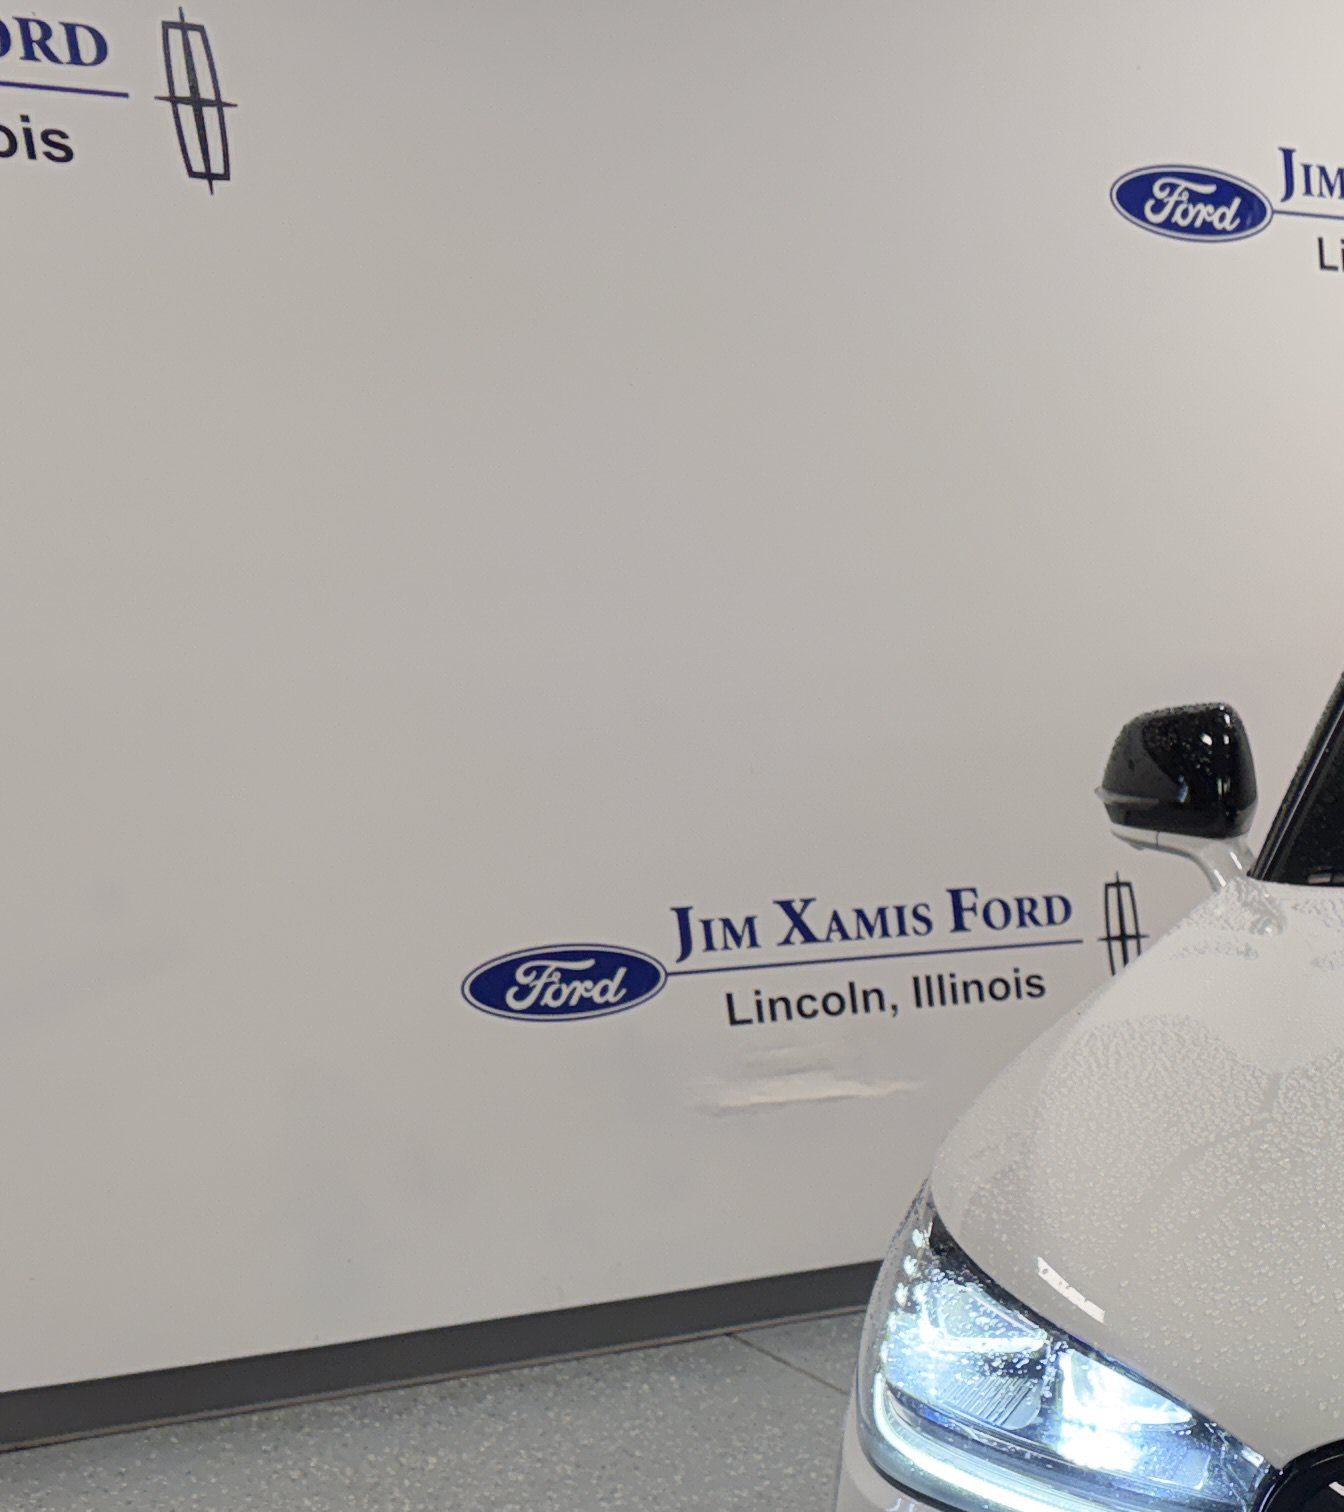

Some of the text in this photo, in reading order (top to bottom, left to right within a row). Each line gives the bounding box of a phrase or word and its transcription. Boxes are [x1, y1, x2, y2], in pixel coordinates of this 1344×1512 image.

[0, 17, 107, 66] RD
[1144, 176, 1240, 232] Ford
[671, 888, 1071, 963] JIM XAMIS FORD
[505, 959, 627, 1009] Ford
[726, 968, 1045, 1026] Lincoln, Illinois
